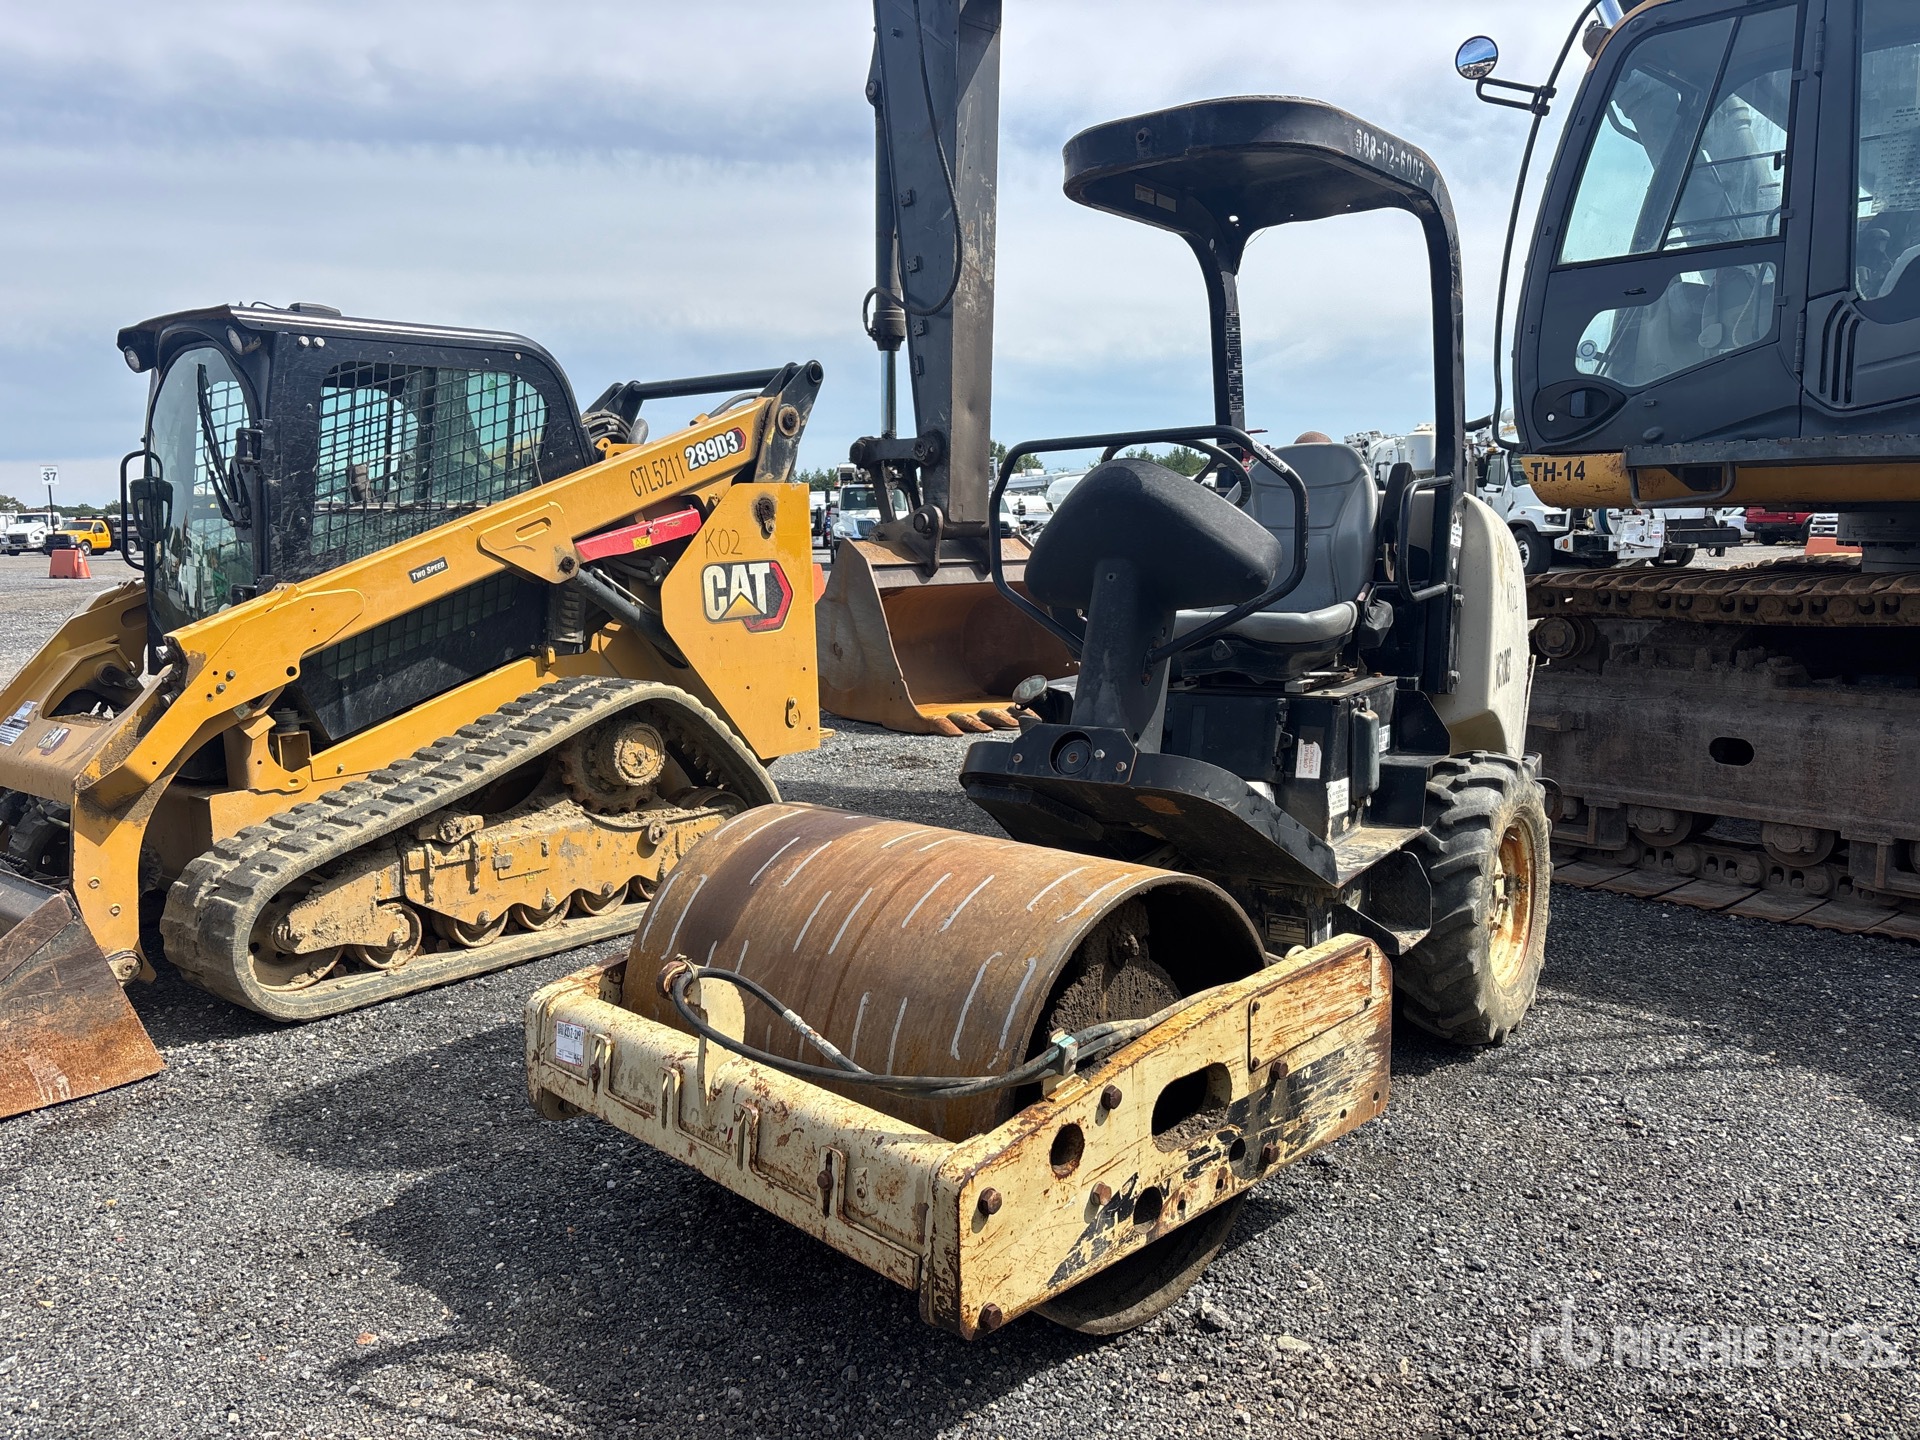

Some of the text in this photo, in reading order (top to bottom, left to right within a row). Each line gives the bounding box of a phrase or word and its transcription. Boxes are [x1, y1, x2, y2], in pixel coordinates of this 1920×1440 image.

[685, 431, 739, 471] 289D3
[43, 471, 57, 481] 37
[630, 452, 685, 497] CTL5211
[1531, 461, 1586, 482] TH-14
[703, 562, 770, 620] CAT
